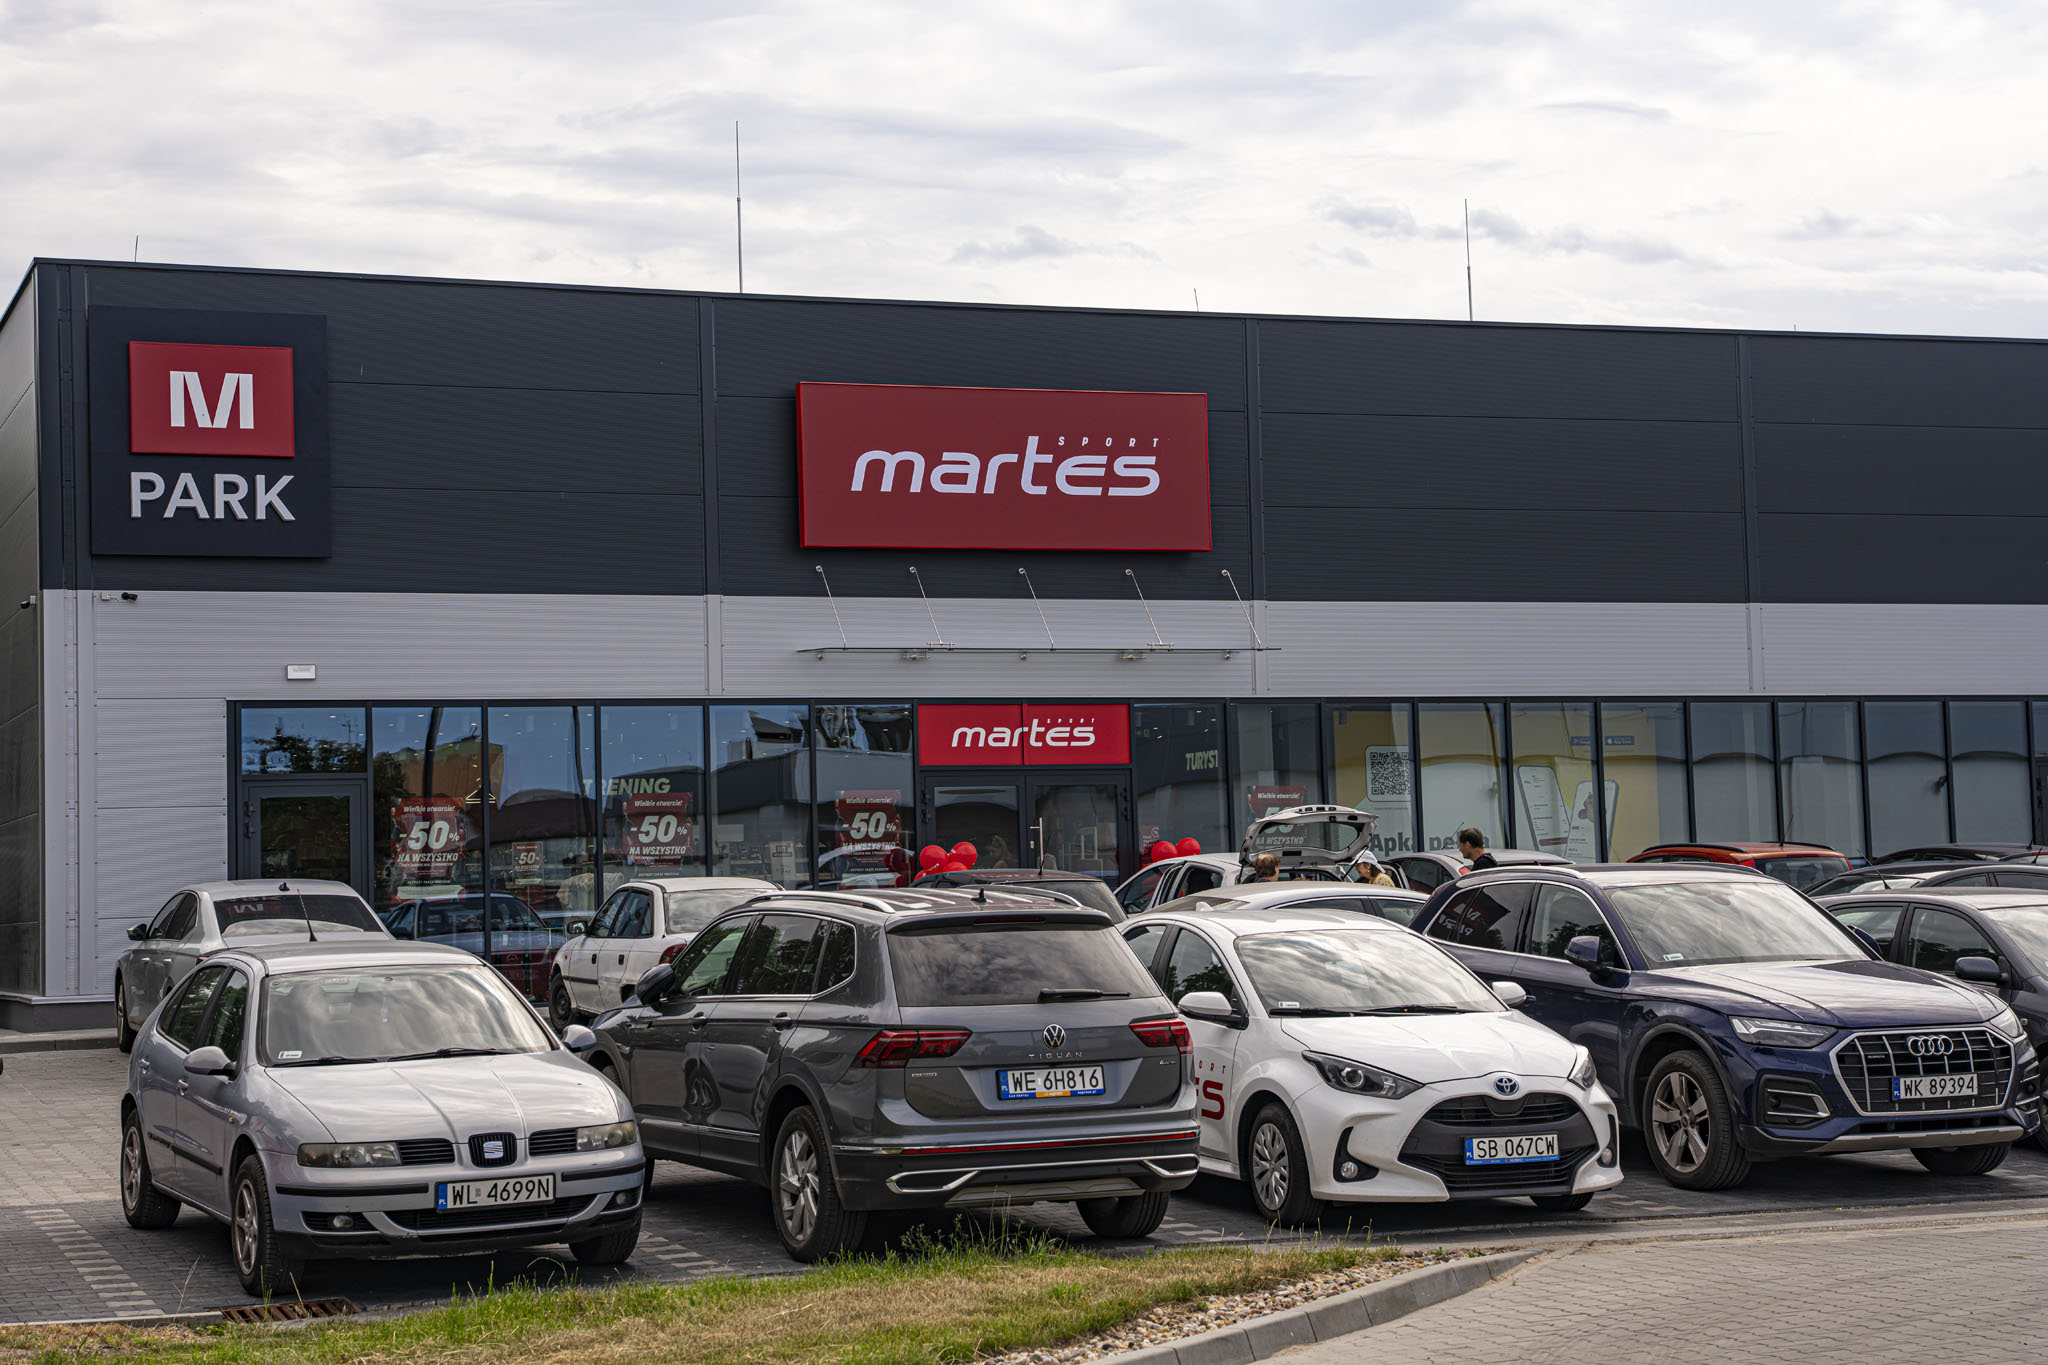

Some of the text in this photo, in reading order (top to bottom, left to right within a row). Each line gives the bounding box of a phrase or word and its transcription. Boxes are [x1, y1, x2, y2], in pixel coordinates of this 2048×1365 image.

[169, 370, 255, 429] M
[1058, 436, 1159, 447] SPORT
[850, 435, 1161, 497] martes
[130, 471, 296, 521] PARK
[951, 718, 1096, 748] martes
[400, 820, 460, 850] -50%
[630, 815, 688, 843] -50%
[842, 812, 896, 839] -50%
[397, 852, 459, 862] NA WSZYSTKO
[629, 845, 687, 855] NA WSZYSTKO
[1028, 1051, 1082, 1060] TIGUAN
[1012, 1071, 1036, 1092] WE
[1043, 1069, 1099, 1090] 6H816
[1904, 1079, 1923, 1097] WK
[1929, 1076, 1974, 1095] 89394
[1476, 1140, 1498, 1158] SB
[1505, 1136, 1554, 1157] 067CW
[452, 1184, 478, 1206] WL
[487, 1178, 549, 1202] 4699N
